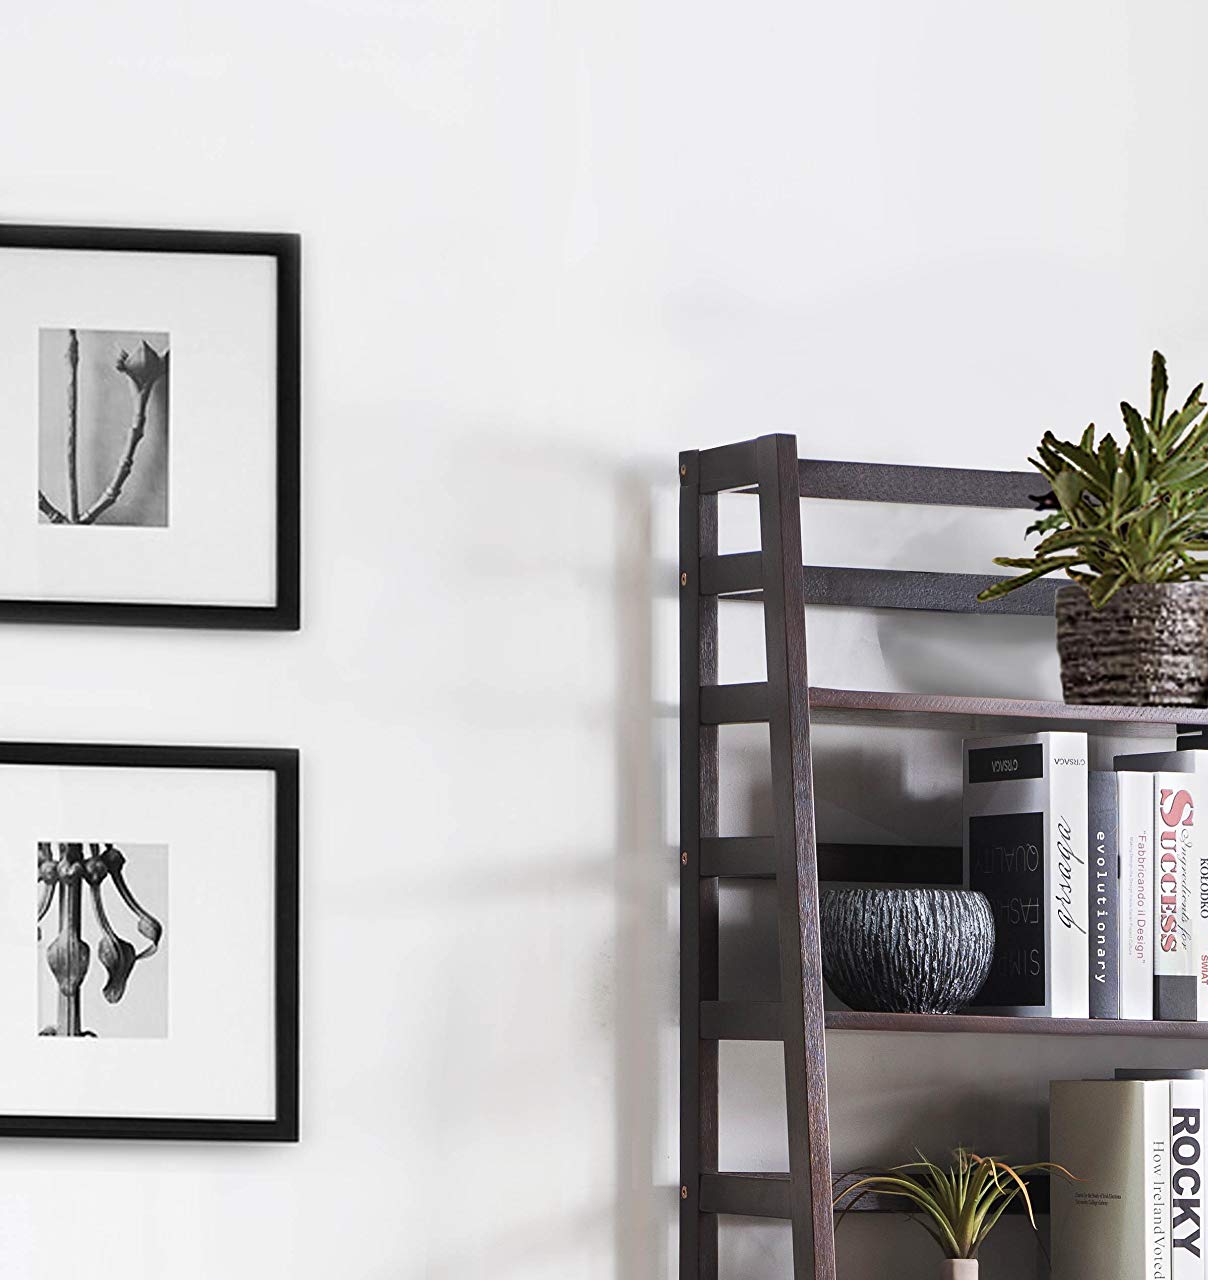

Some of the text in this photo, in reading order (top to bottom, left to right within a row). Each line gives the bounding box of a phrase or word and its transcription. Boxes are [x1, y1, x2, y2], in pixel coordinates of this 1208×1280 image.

[1095, 831, 1107, 984] evolutionary
[1160, 788, 1195, 953] SUCCESS
[1174, 828, 1192, 951] Ingredients for
[1200, 857, 1208, 919] KOŁODKO
[1153, 1141, 1165, 1176] How
[1172, 1108, 1201, 1259] ROCKY
